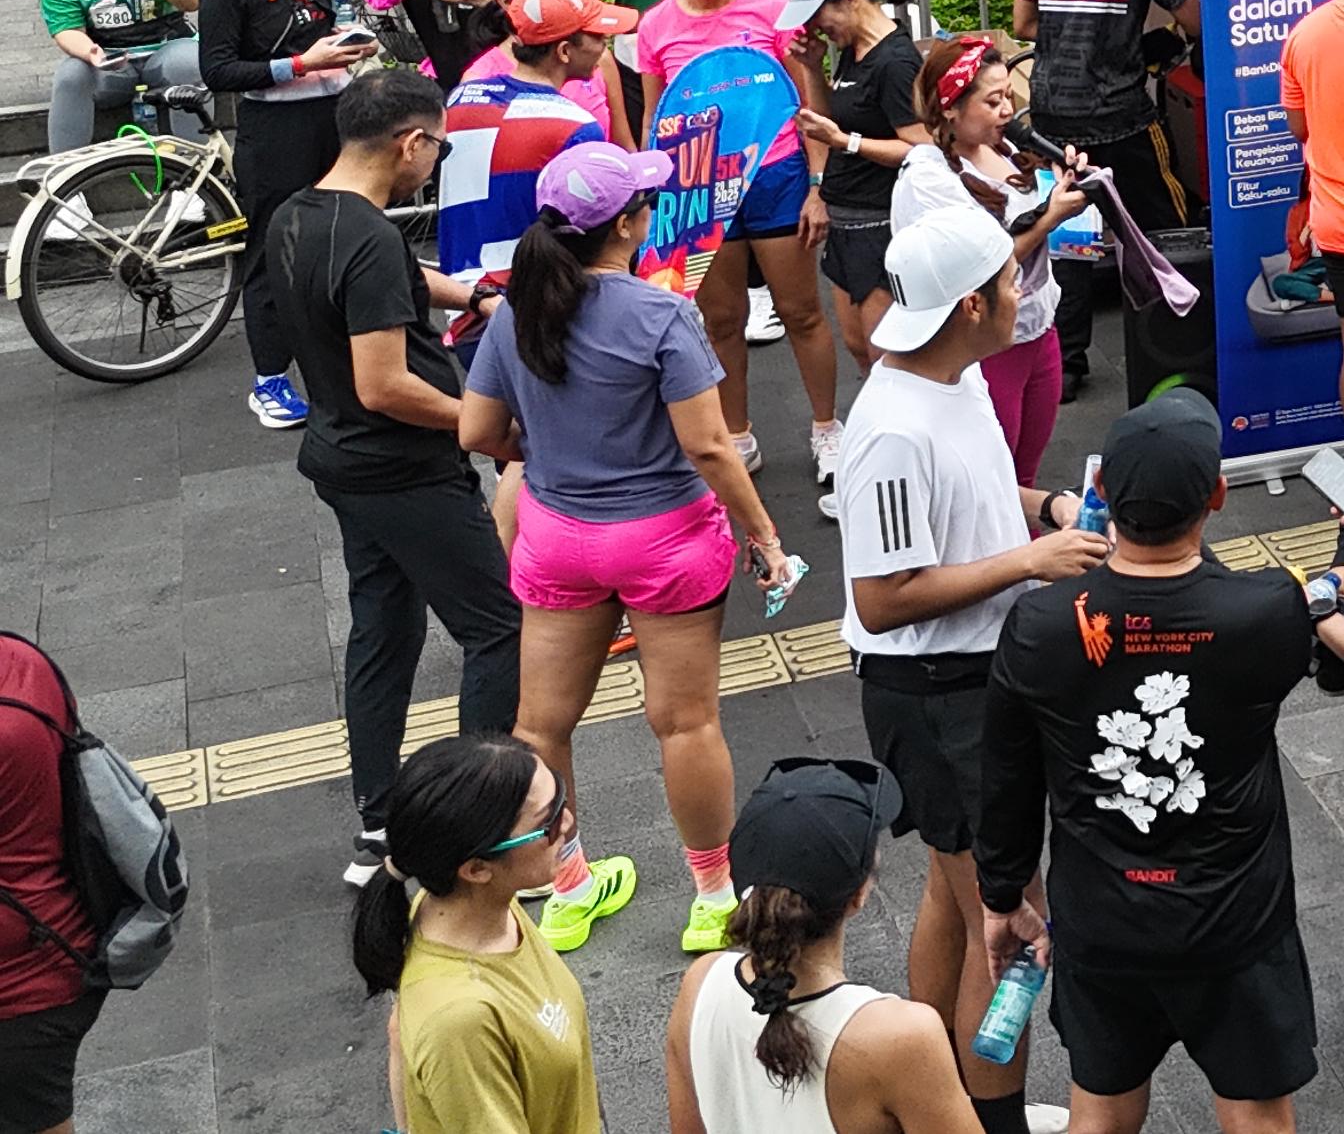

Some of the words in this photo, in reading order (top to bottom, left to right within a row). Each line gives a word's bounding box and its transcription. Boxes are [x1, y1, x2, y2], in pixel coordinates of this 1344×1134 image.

[1231, 24, 1288, 47] Satu
[754, 73, 775, 85] VISA
[656, 114, 684, 137] SSF
[1234, 115, 1266, 126] Bebas
[1234, 123, 1269, 136] Admin
[668, 128, 716, 188] UN
[1235, 142, 1298, 159] Pengelolaan
[715, 155, 742, 180] 5K
[1235, 153, 1289, 169] Keuangan
[1236, 181, 1260, 192] Fitur
[1236, 186, 1290, 203] Saku-saku
[714, 189, 740, 205] 2025
[1125, 613, 1152, 630] tcs
[1125, 633, 1151, 643] NEW
[1155, 632, 1185, 642] YORK
[1187, 631, 1214, 642] CITY
[1125, 644, 1191, 654] MARATHON
[1125, 869, 1177, 883] BANDIT
